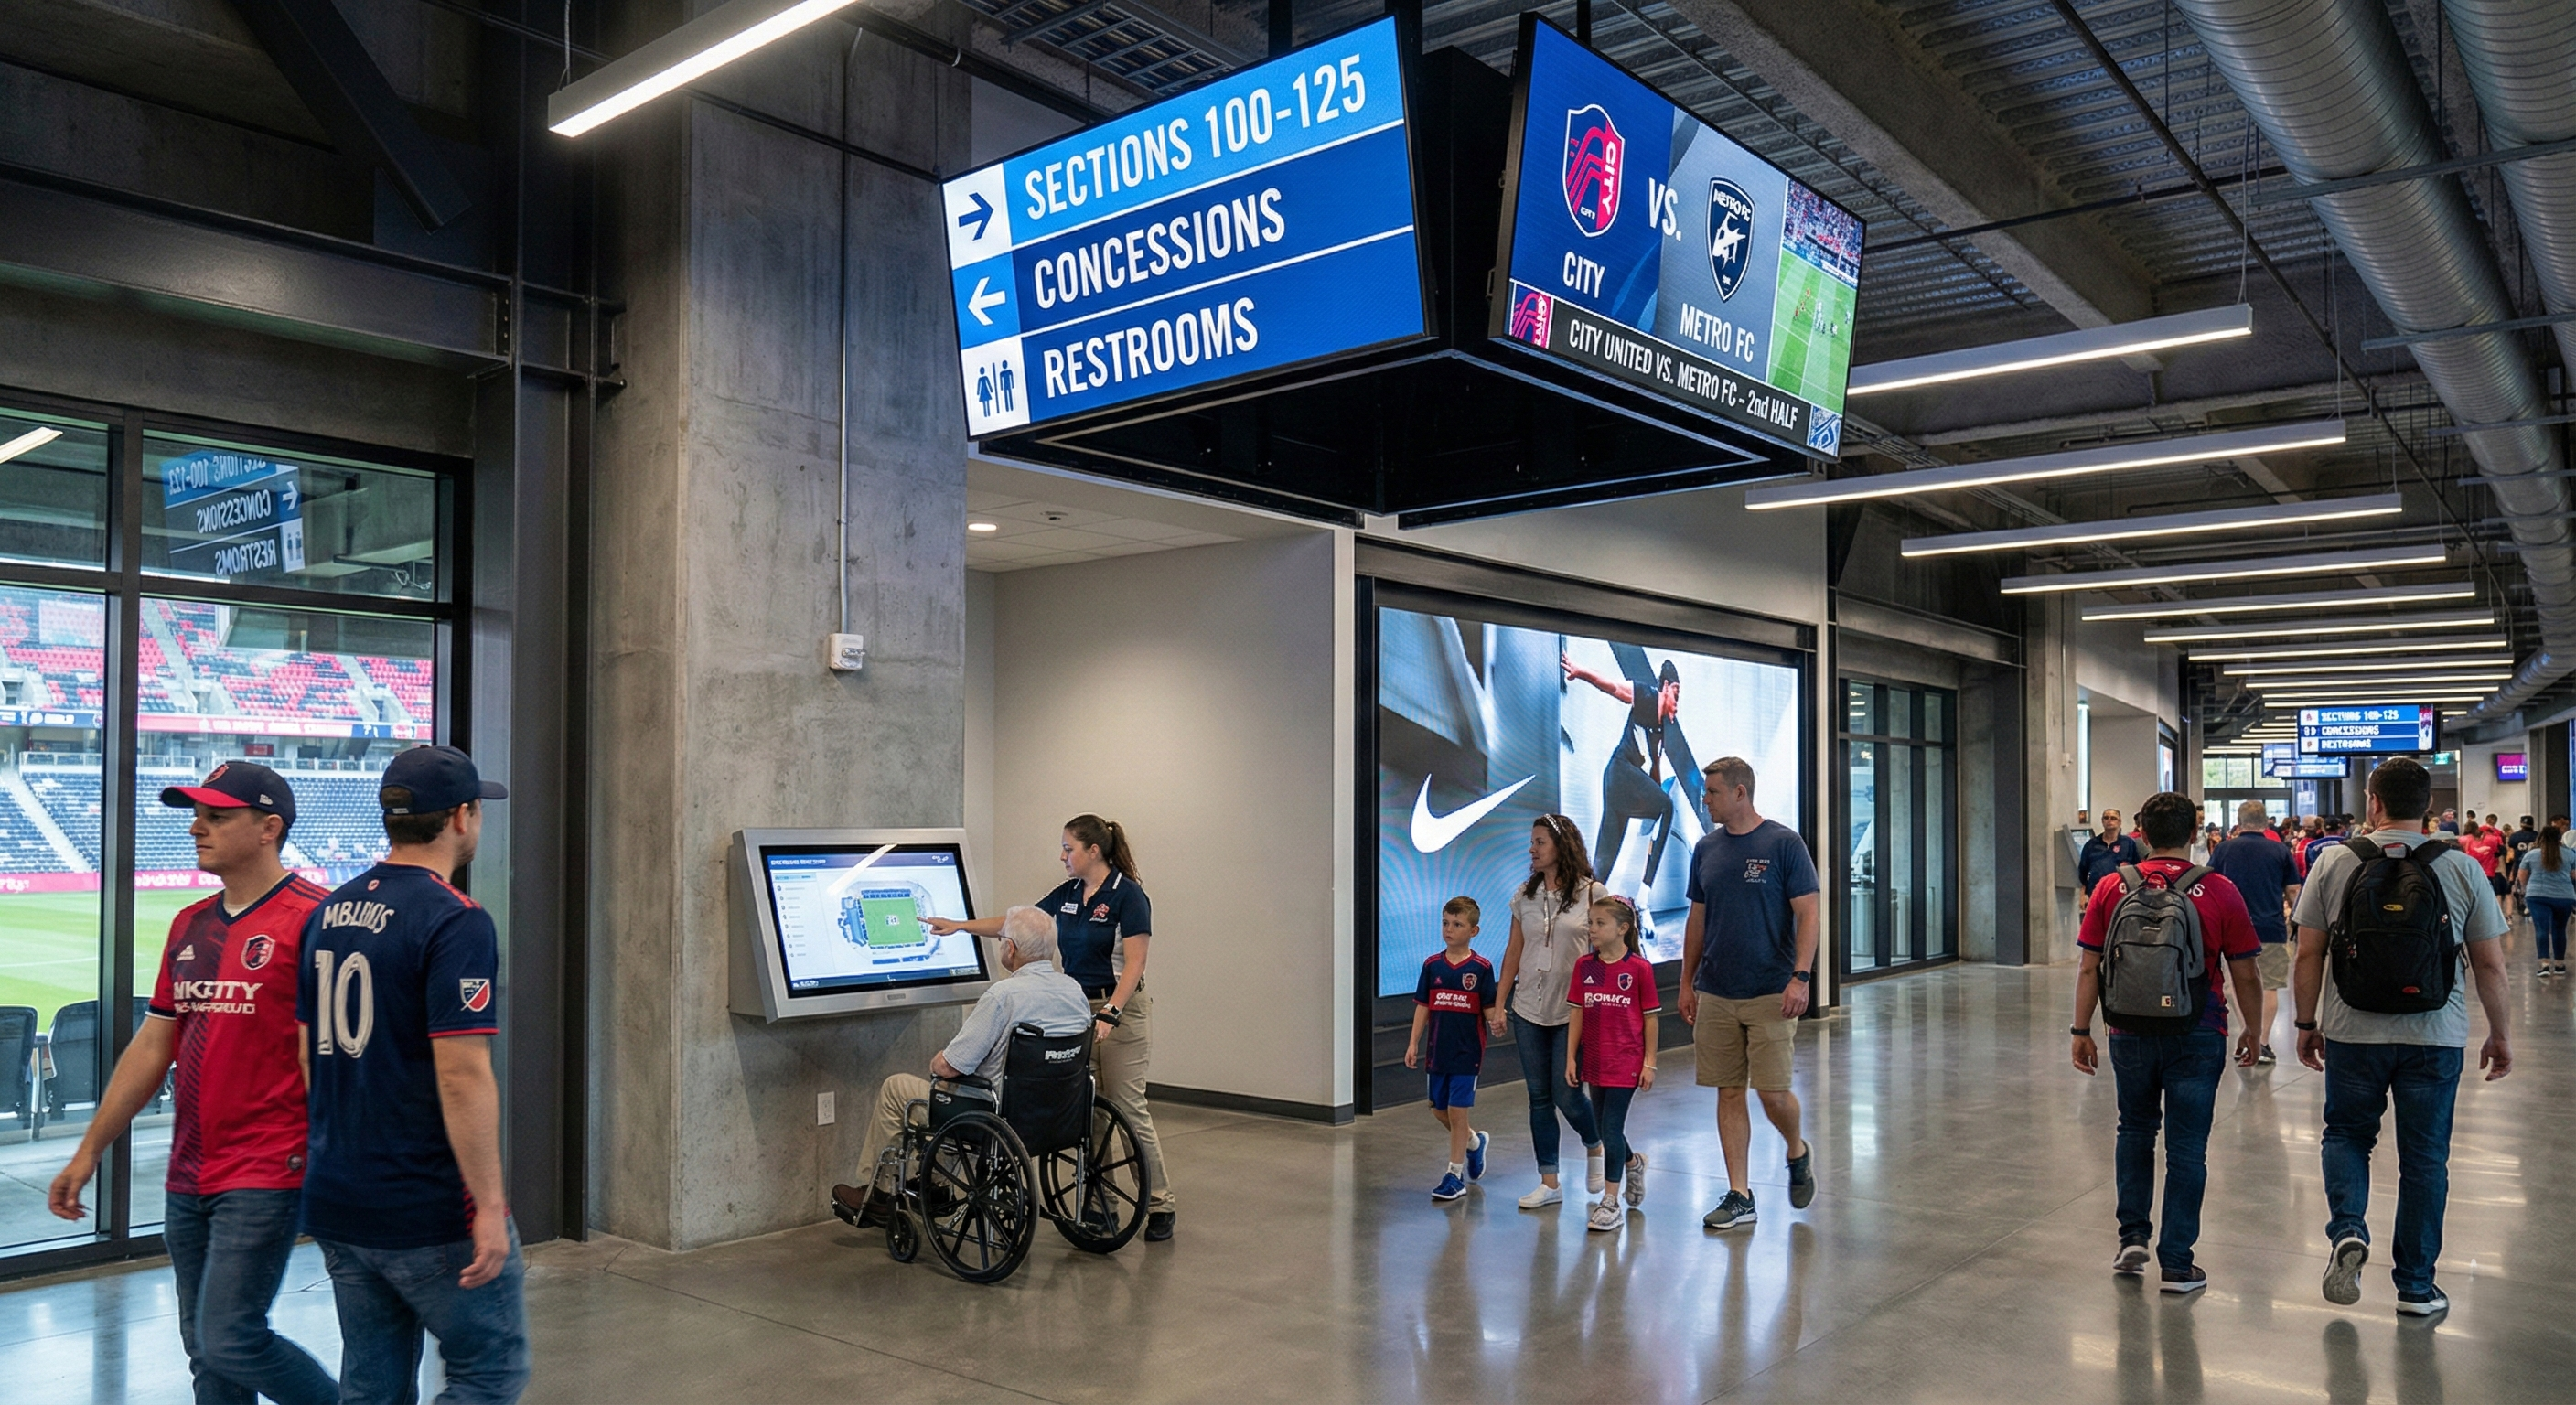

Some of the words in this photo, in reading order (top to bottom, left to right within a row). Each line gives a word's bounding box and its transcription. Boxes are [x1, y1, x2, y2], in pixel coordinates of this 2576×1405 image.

[1025, 116, 1192, 220] SECTIONS
[1205, 53, 1367, 158] 100-125
[1602, 141, 1616, 216] CITY
[1034, 188, 1285, 309] CONCESSIONS
[1649, 177, 1681, 241] VS.
[1563, 251, 1605, 298] CITY
[1043, 297, 1259, 399] RESTROOMS
[1569, 318, 1604, 356] CITY
[1604, 332, 1653, 375] UNITED
[1656, 354, 1674, 384] VS.
[1677, 362, 1720, 400] METRO
[1721, 379, 1738, 408] FC
[1746, 389, 1770, 420] 2nd
[1770, 399, 1798, 431] HALF
[1680, 303, 1732, 354] METRO
[1734, 327, 1755, 362] FC
[315, 949, 375, 1058] 10
